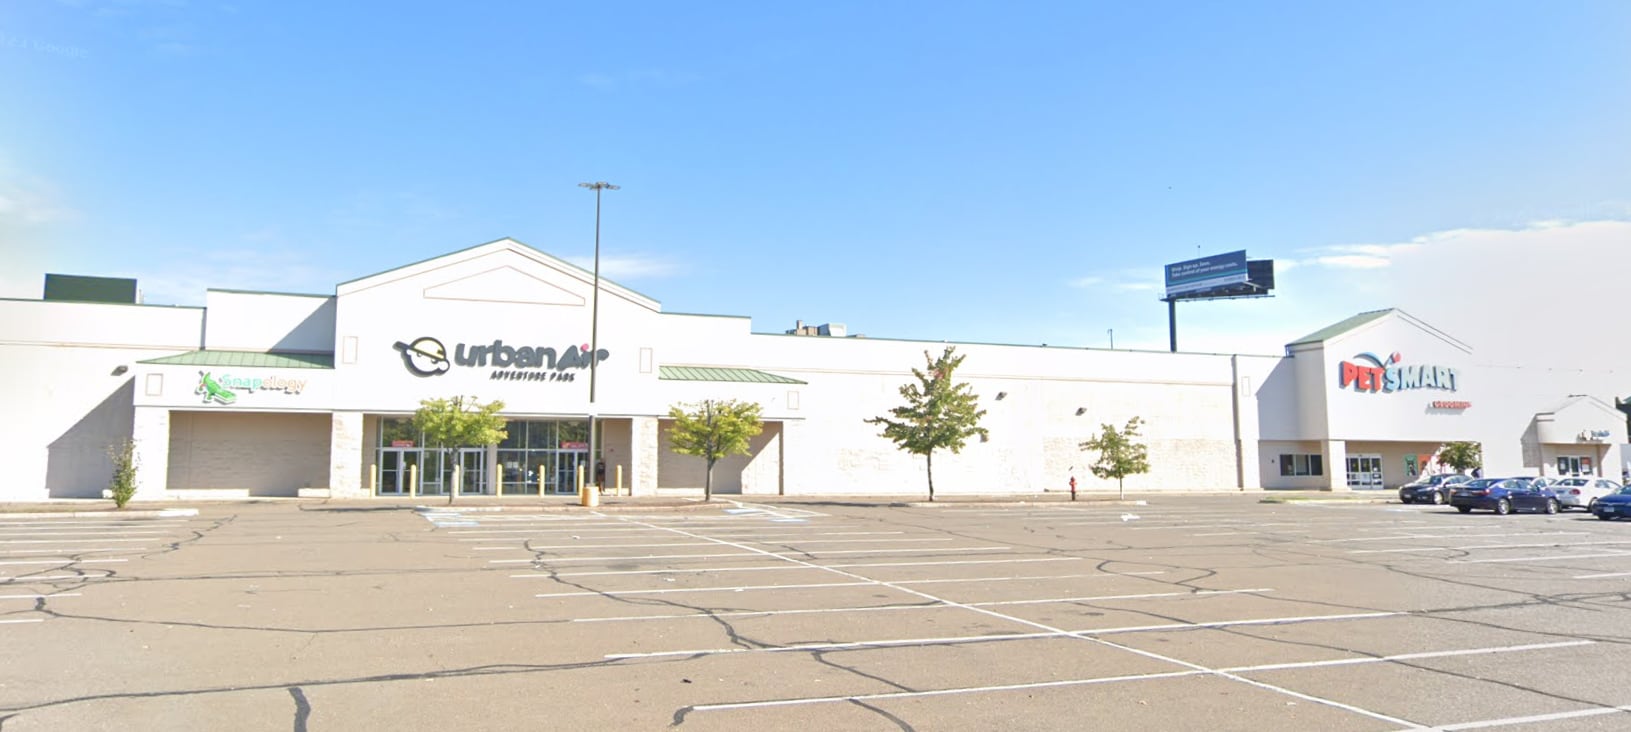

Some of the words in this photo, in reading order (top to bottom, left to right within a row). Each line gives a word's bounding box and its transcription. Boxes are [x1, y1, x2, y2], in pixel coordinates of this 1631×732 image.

[454, 339, 557, 370] urban
[557, 343, 609, 371] Air
[222, 374, 306, 393] Snapology
[489, 370, 547, 382] ADVENTURE
[549, 371, 576, 382] PARK
